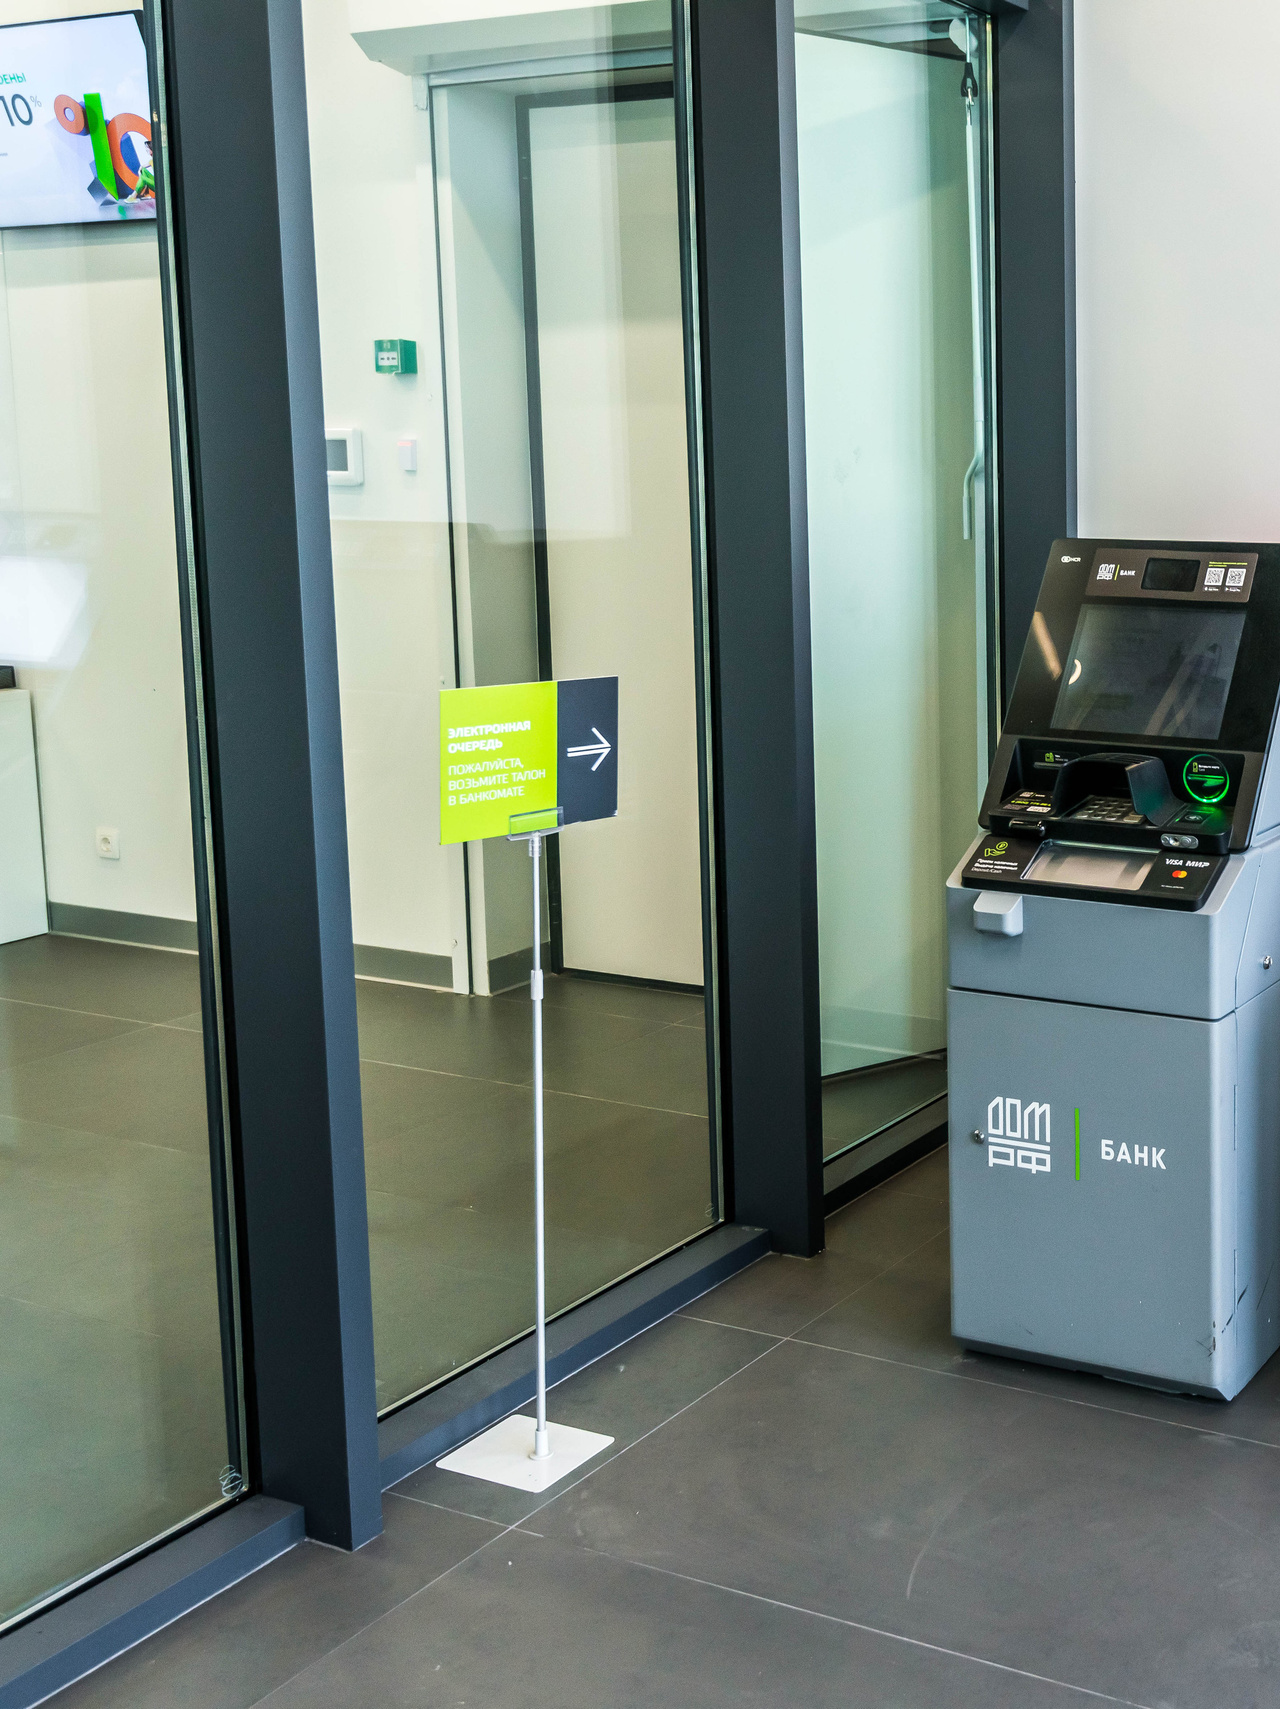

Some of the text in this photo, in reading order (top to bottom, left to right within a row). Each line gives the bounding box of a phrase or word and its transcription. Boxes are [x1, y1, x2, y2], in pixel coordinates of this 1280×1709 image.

[448, 720, 531, 739] ЭЛЕКТРОННАЯ
[448, 739, 503, 754] ОЧЕРЕДЬ
[448, 758, 524, 776] ПОЖАЛУЙСТА,
[448, 768, 546, 791] ВОЗЬМИТЕ ТАЛОН
[448, 785, 525, 806] В БАНКОМАТЕ
[1165, 858, 1183, 866] VISA
[987, 1096, 1051, 1143] ДОМ
[988, 1145, 1051, 1174] РФ
[1101, 1139, 1167, 1170] БАНК
